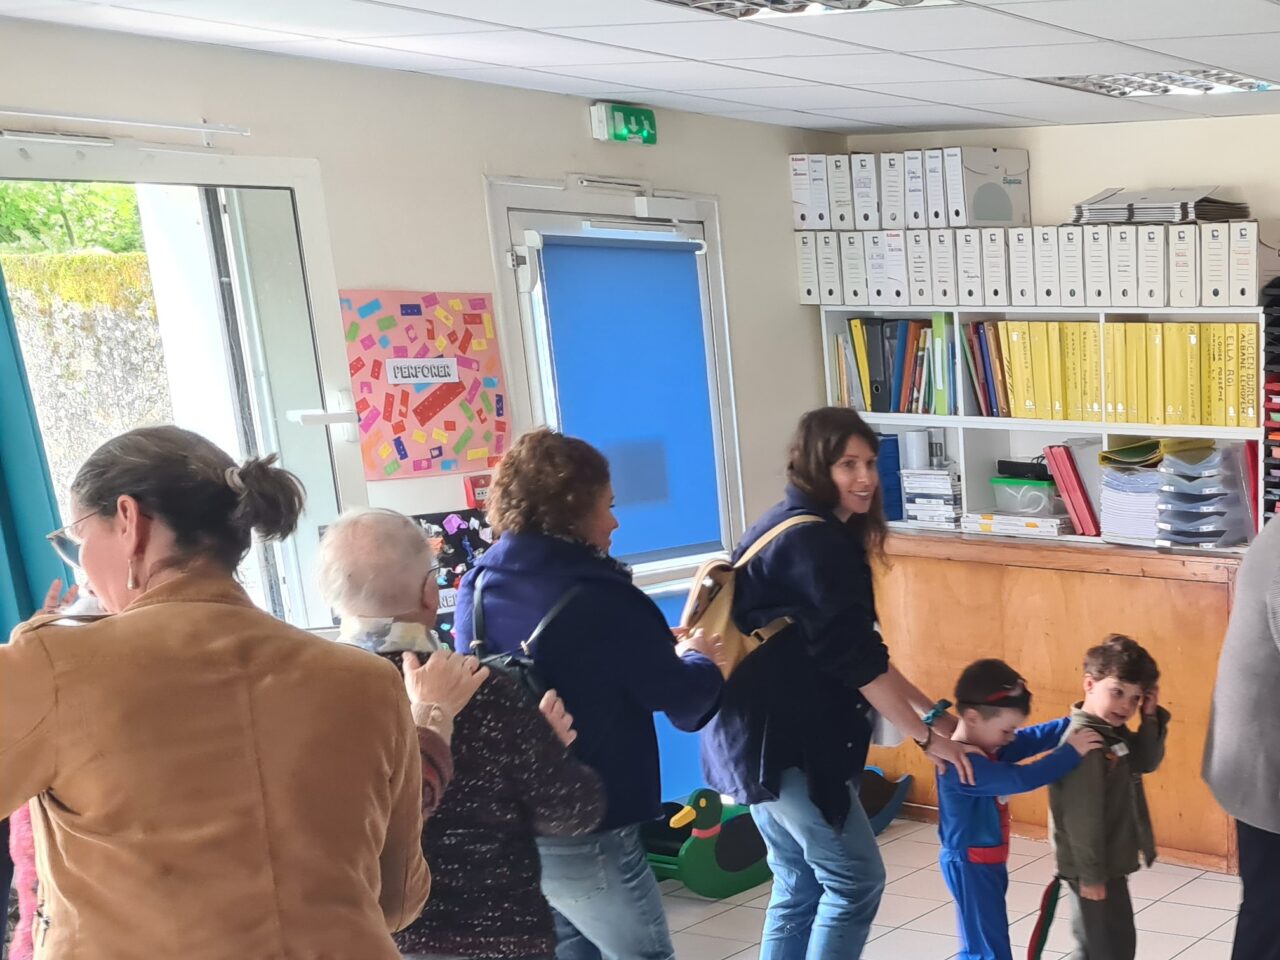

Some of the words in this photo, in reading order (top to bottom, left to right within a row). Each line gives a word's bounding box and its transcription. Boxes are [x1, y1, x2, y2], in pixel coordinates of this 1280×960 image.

[1227, 335, 1235, 362] ELLA
[1239, 332, 1247, 371] ALBANE
[1246, 332, 1255, 370] LUCIEN
[1227, 369, 1235, 387] ROI
